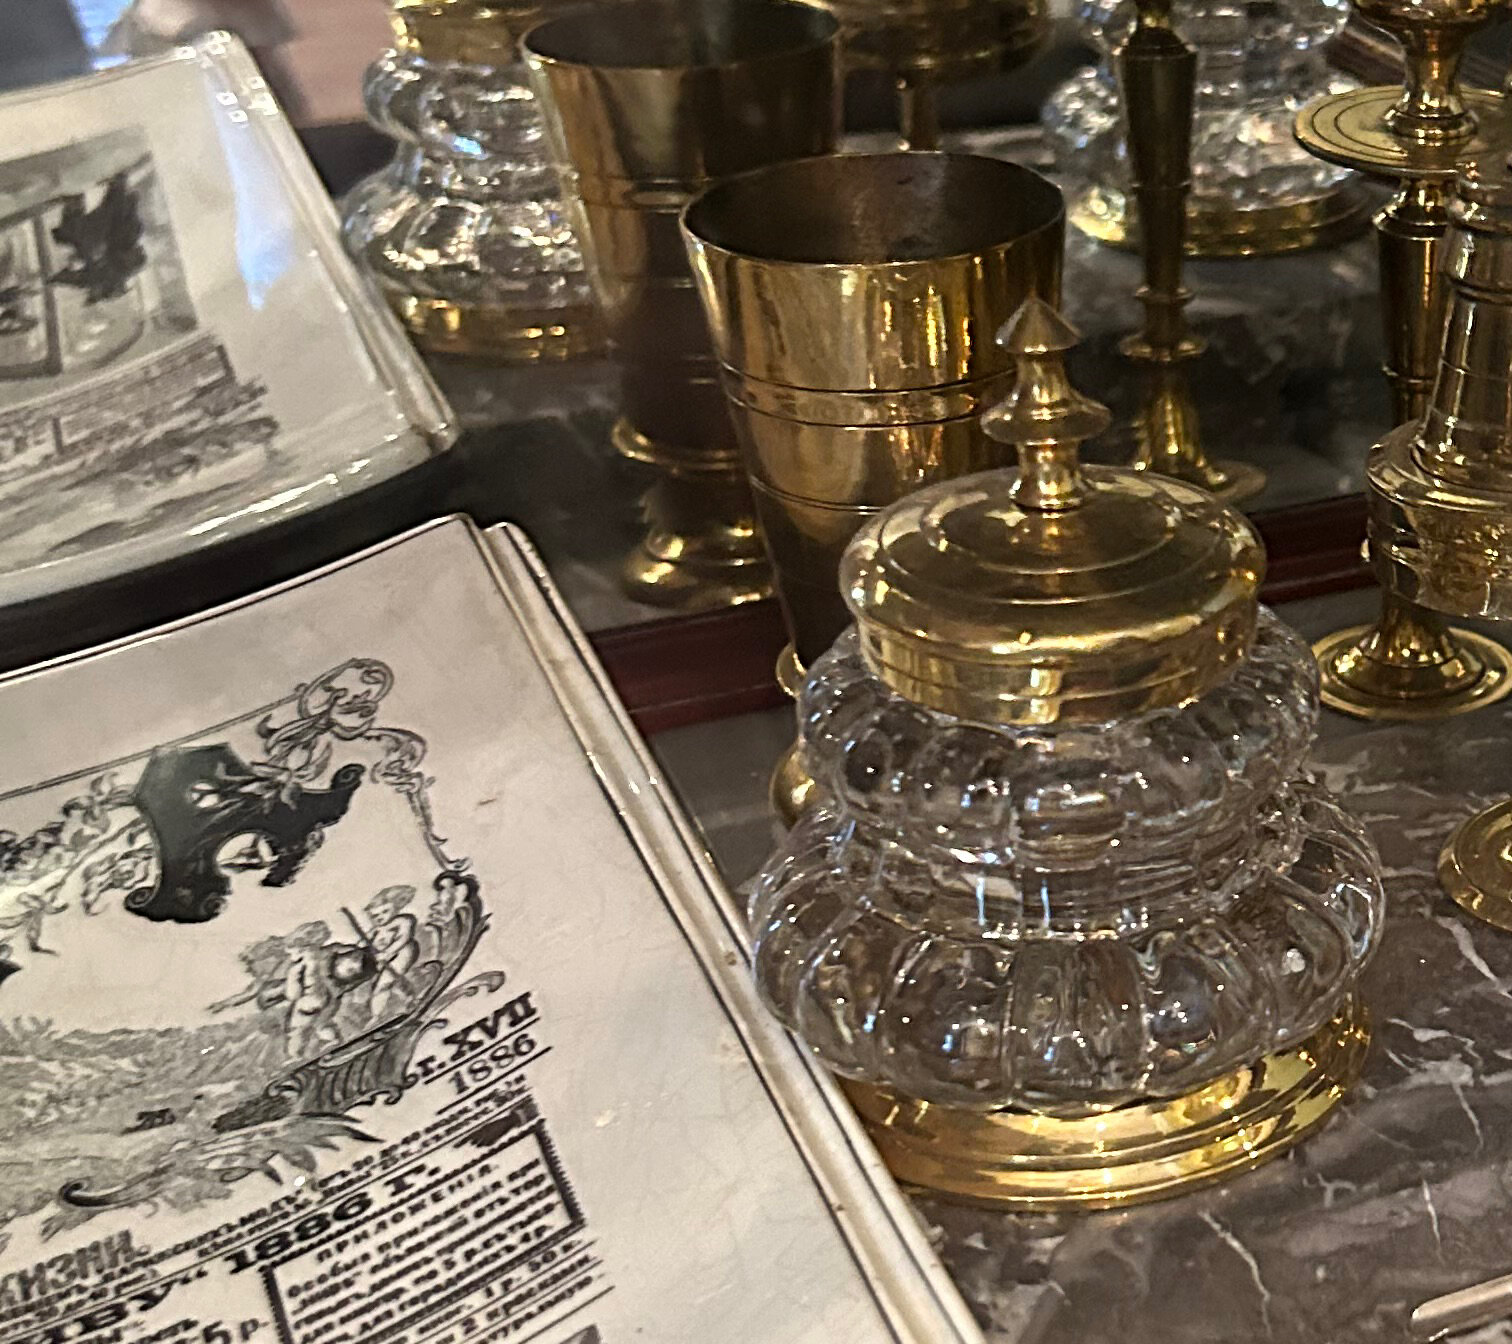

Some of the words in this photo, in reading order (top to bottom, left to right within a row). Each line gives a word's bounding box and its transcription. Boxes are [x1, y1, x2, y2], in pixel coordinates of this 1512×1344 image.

[442, 991, 541, 1062] XVII
[443, 1033, 542, 1095] 1886
[221, 1192, 373, 1275] 1886
[457, 1314, 478, 1335] 2
